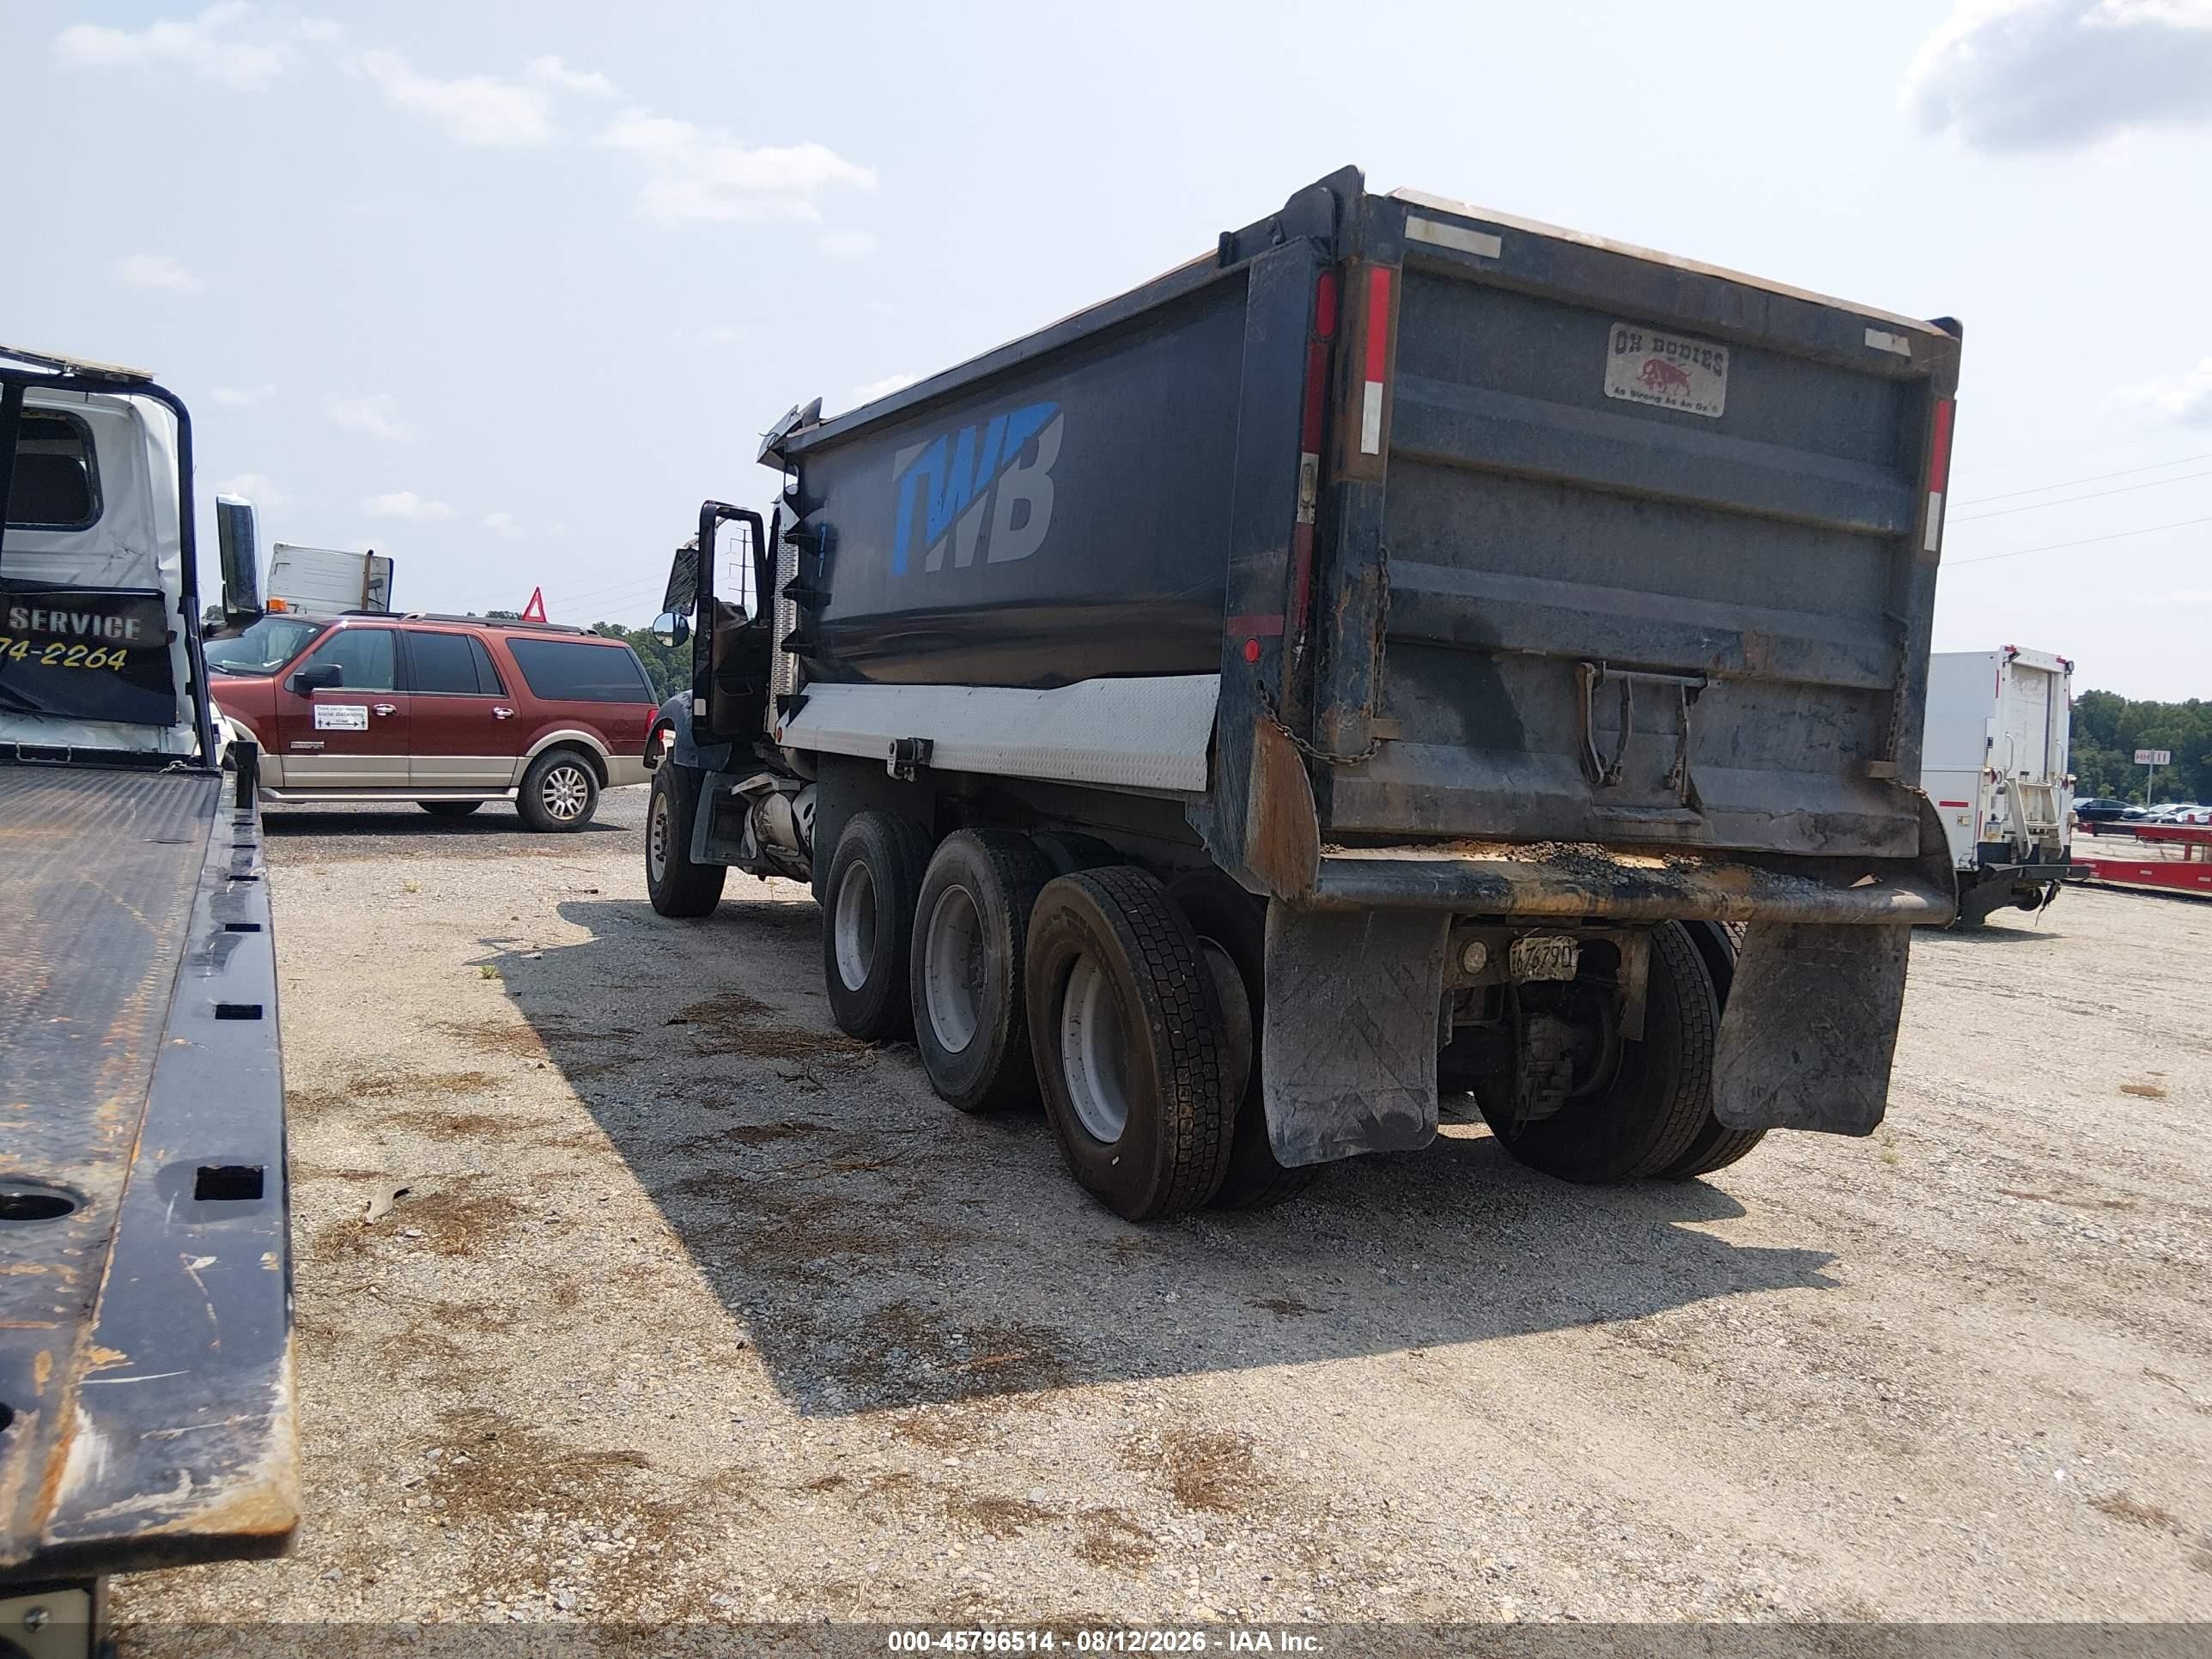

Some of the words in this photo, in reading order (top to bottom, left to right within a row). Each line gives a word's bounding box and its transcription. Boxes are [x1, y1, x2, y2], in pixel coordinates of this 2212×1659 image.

[1652, 337, 1723, 377] BODIES
[1631, 390, 1662, 404] Strong
[9, 606, 141, 640] SERVICE
